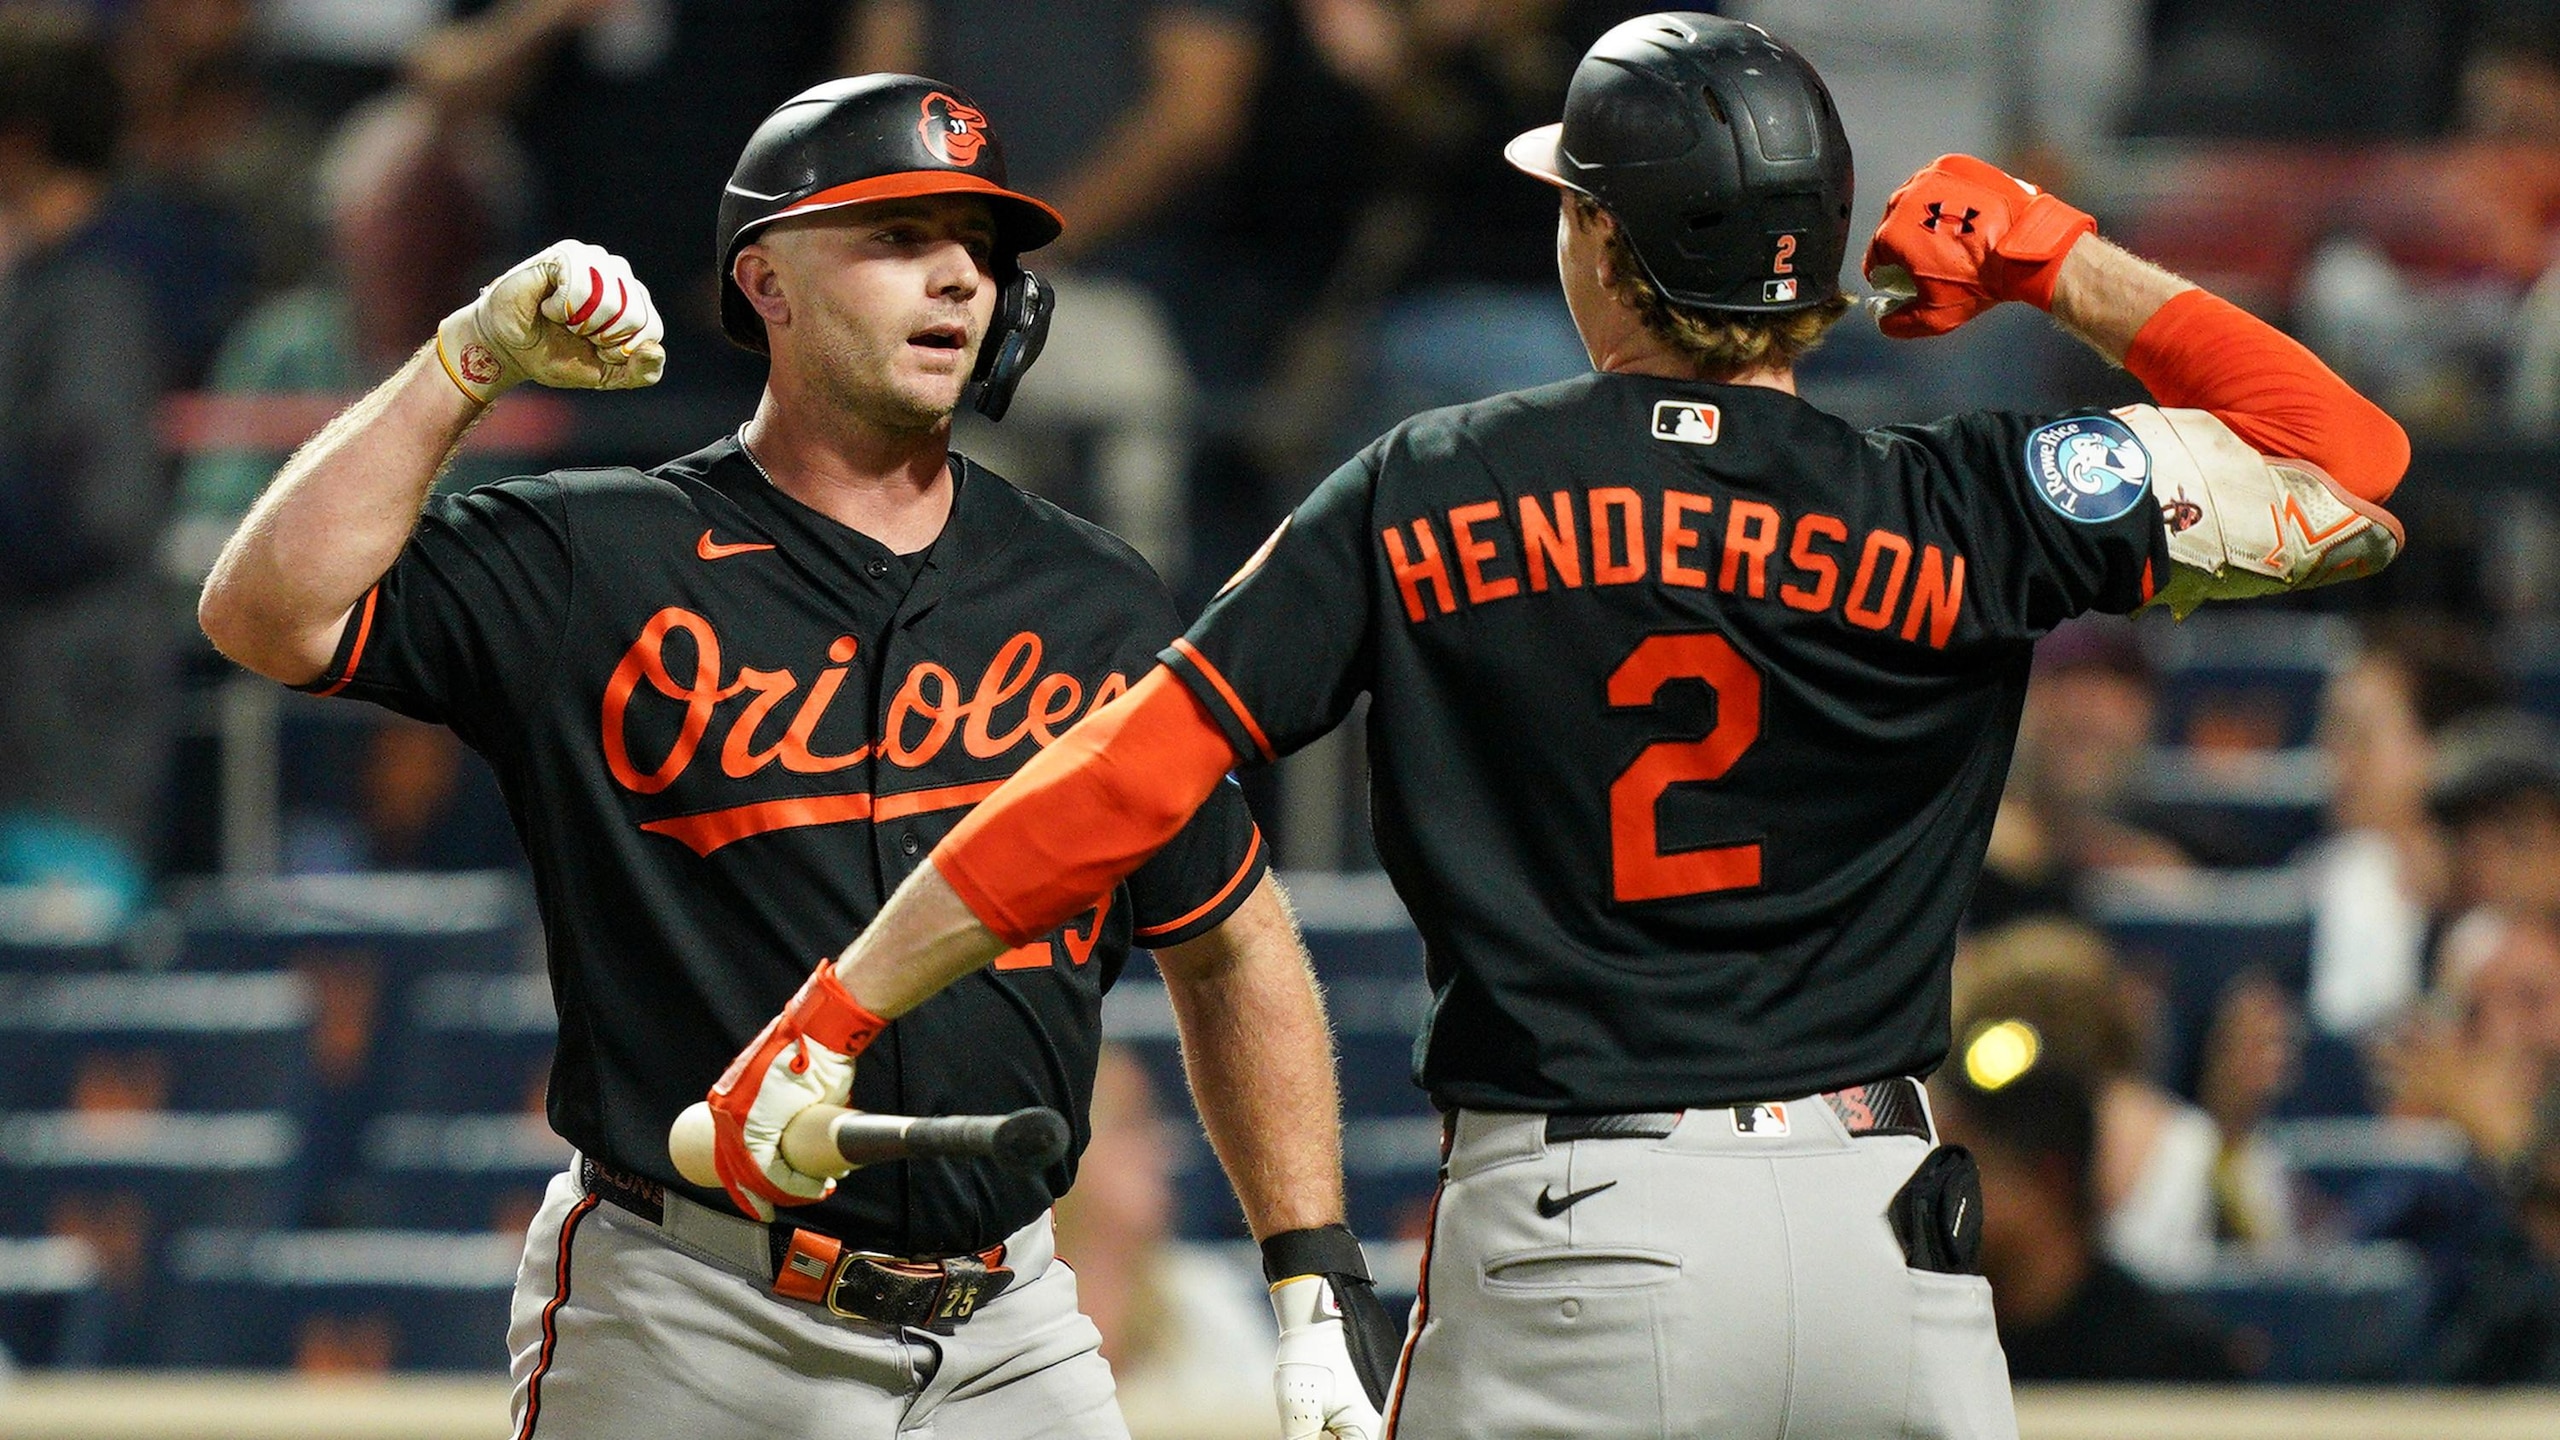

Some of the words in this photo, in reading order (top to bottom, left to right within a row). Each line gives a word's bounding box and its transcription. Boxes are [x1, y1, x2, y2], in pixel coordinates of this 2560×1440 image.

[1774, 234, 1797, 274] 2
[2036, 423, 2080, 447] Price
[2040, 443, 2068, 498] Rowe
[1383, 487, 1965, 650] HENDERSON
[1607, 633, 1762, 902] 2
[940, 1287, 978, 1318] 25
